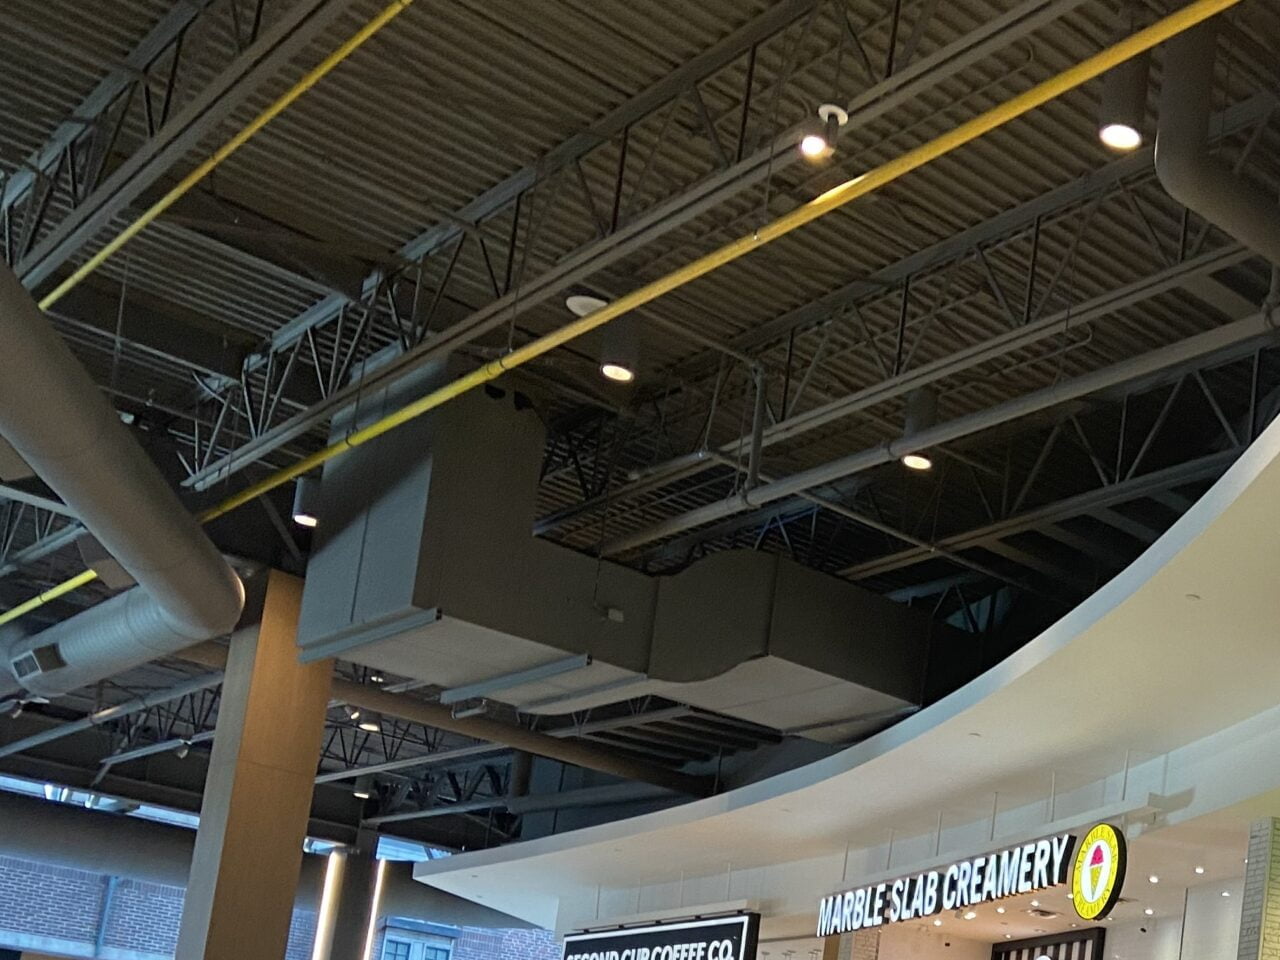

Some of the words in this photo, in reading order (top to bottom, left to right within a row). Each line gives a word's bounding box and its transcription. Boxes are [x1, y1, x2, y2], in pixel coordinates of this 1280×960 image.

[816, 882, 887, 937] MARBLE
[889, 870, 940, 923] SLAB
[942, 833, 1070, 910] CREAMERY
